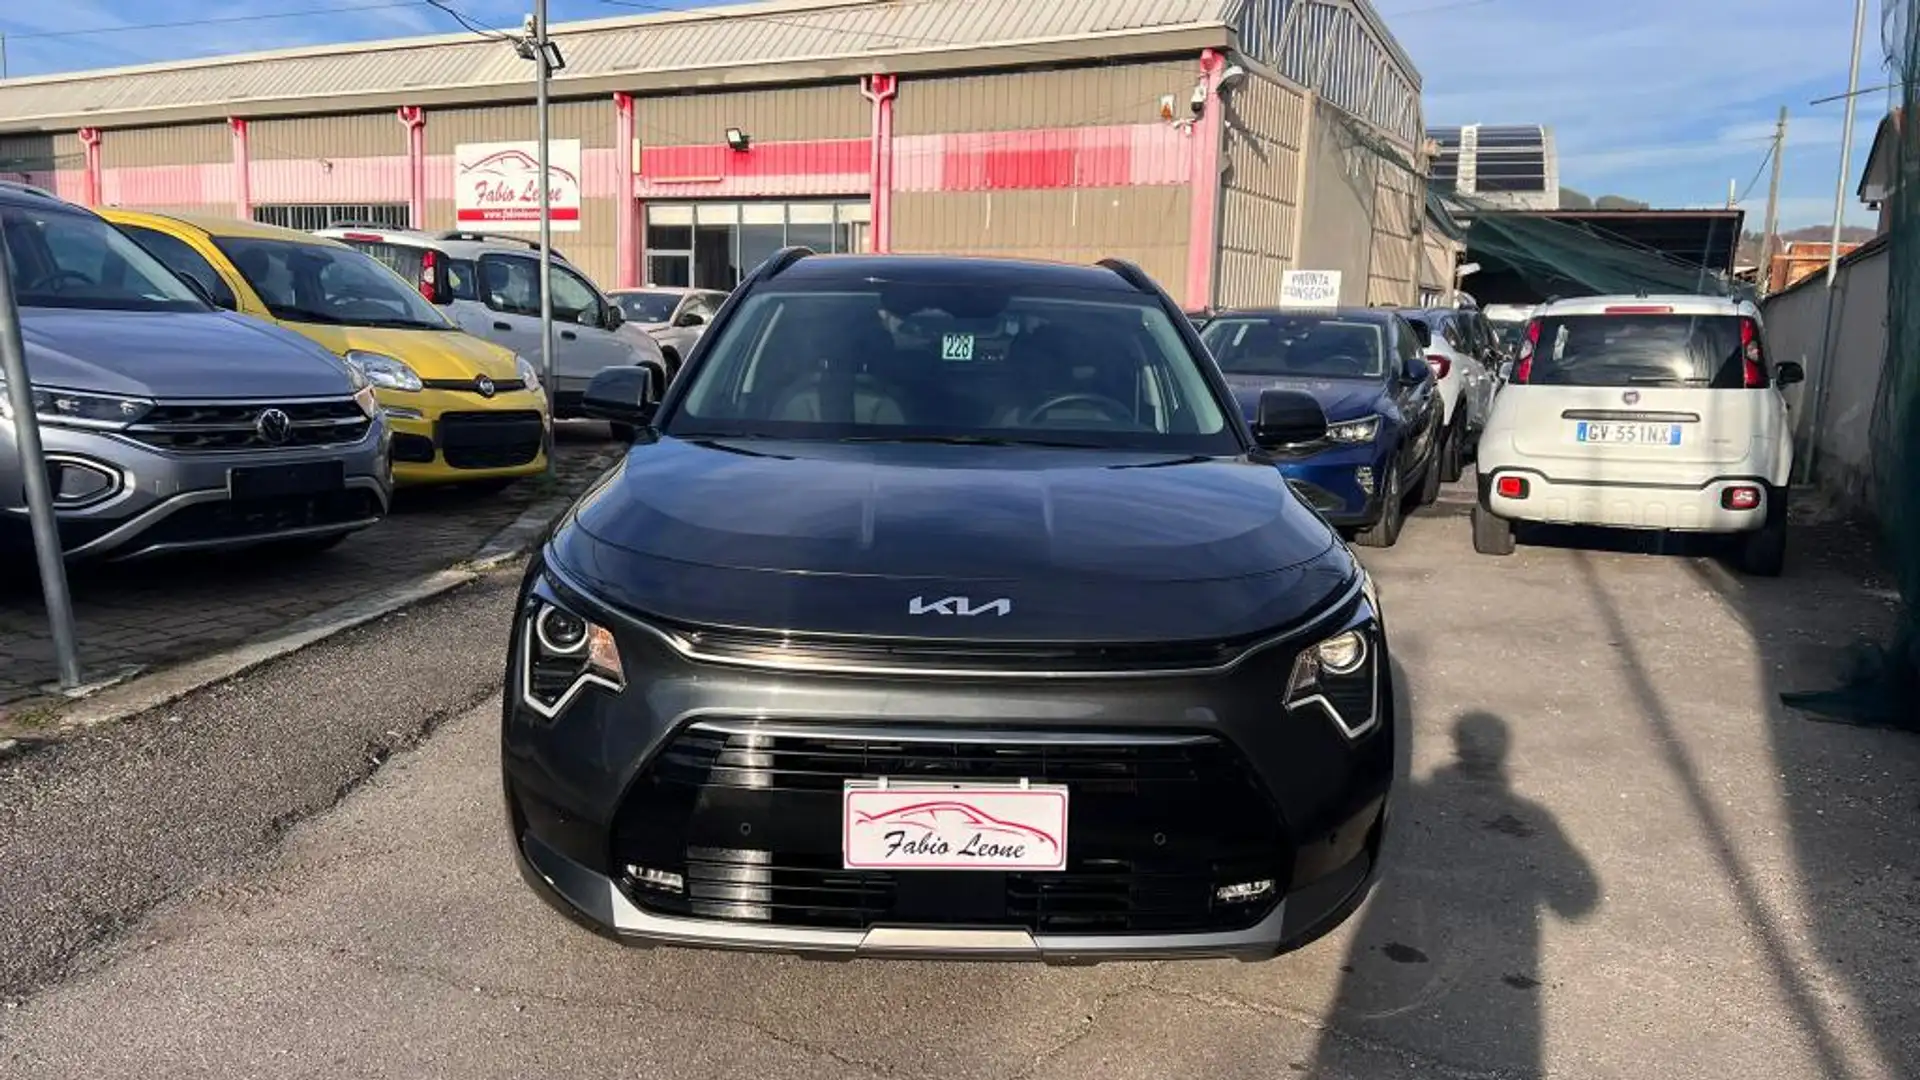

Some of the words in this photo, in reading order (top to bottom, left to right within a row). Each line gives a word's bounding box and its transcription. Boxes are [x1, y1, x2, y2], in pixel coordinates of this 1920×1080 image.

[475, 179, 515, 206] Fabio
[518, 179, 562, 203] Lene
[1292, 272, 1329, 286] PRONTA
[946, 334, 969, 358] 228
[1588, 423, 1609, 441] GV
[909, 596, 1011, 616] KIA
[883, 830, 950, 858] Fabio
[956, 832, 1026, 858] Leone
